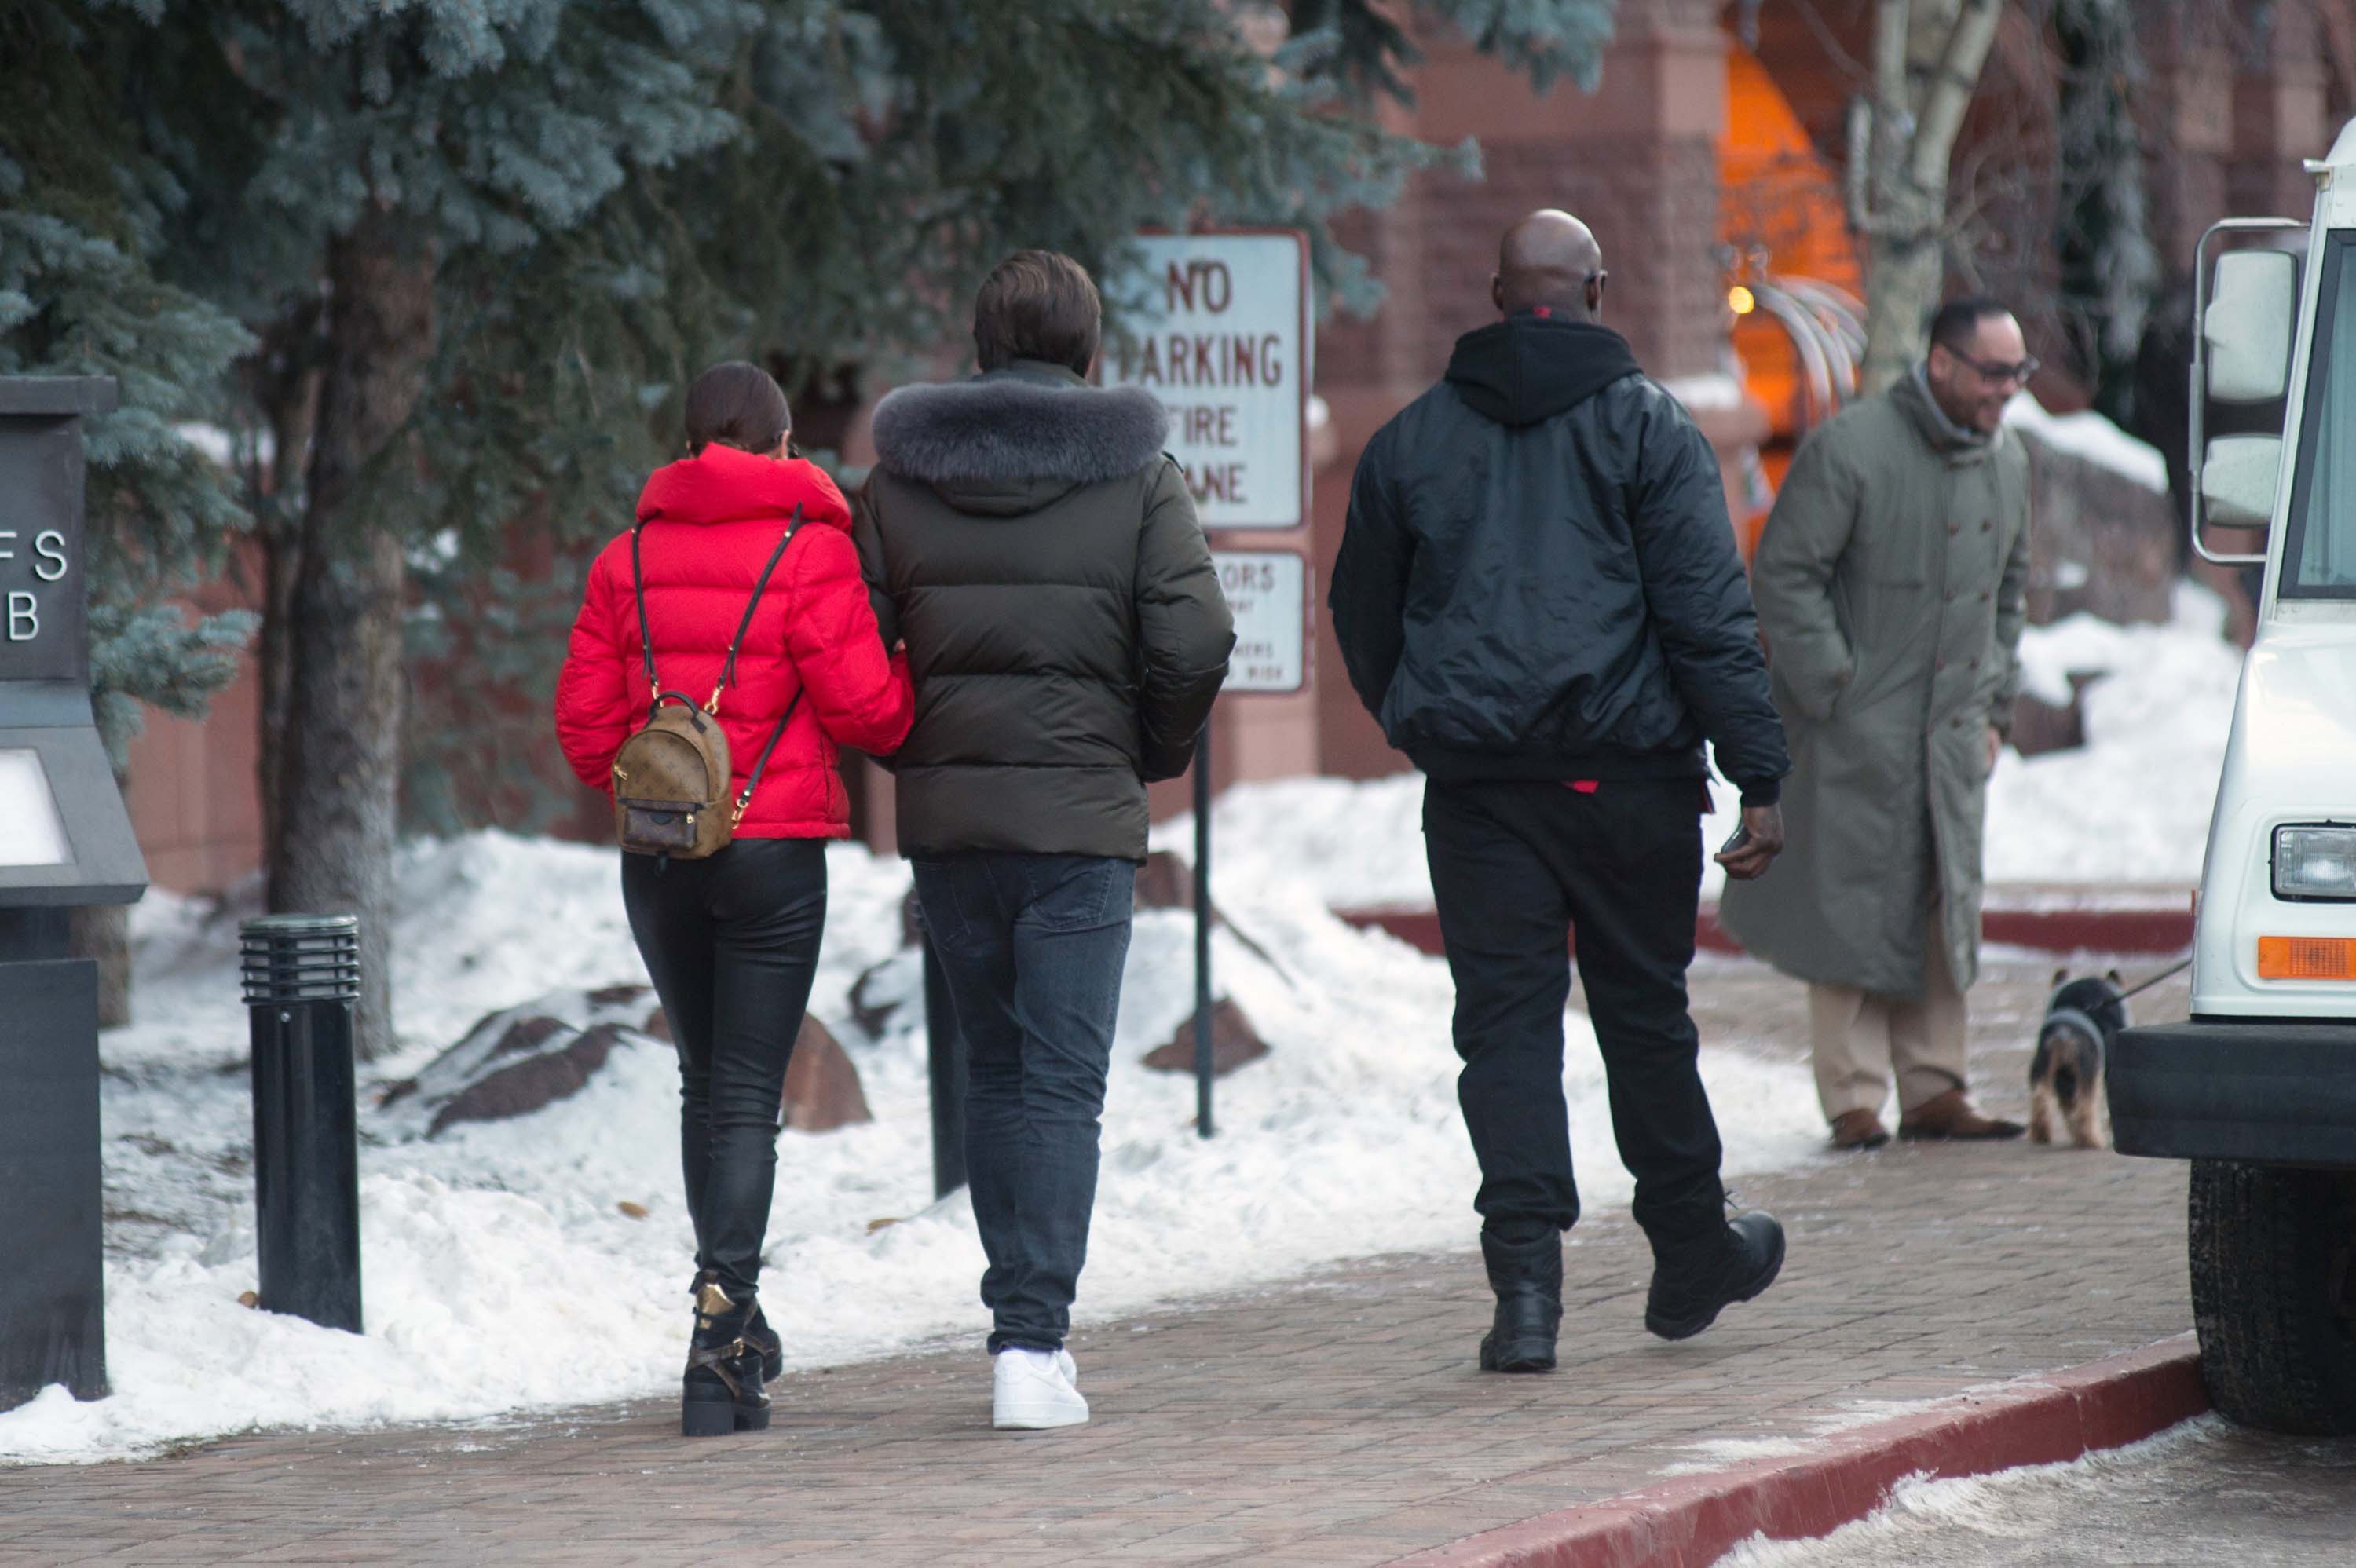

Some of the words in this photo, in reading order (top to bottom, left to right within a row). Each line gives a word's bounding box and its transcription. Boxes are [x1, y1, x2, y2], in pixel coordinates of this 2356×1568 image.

[1168, 260, 1232, 314] NO
[1170, 405, 1238, 447] IRE
[1222, 562, 1275, 592] ORS
[8, 591, 40, 641] B
